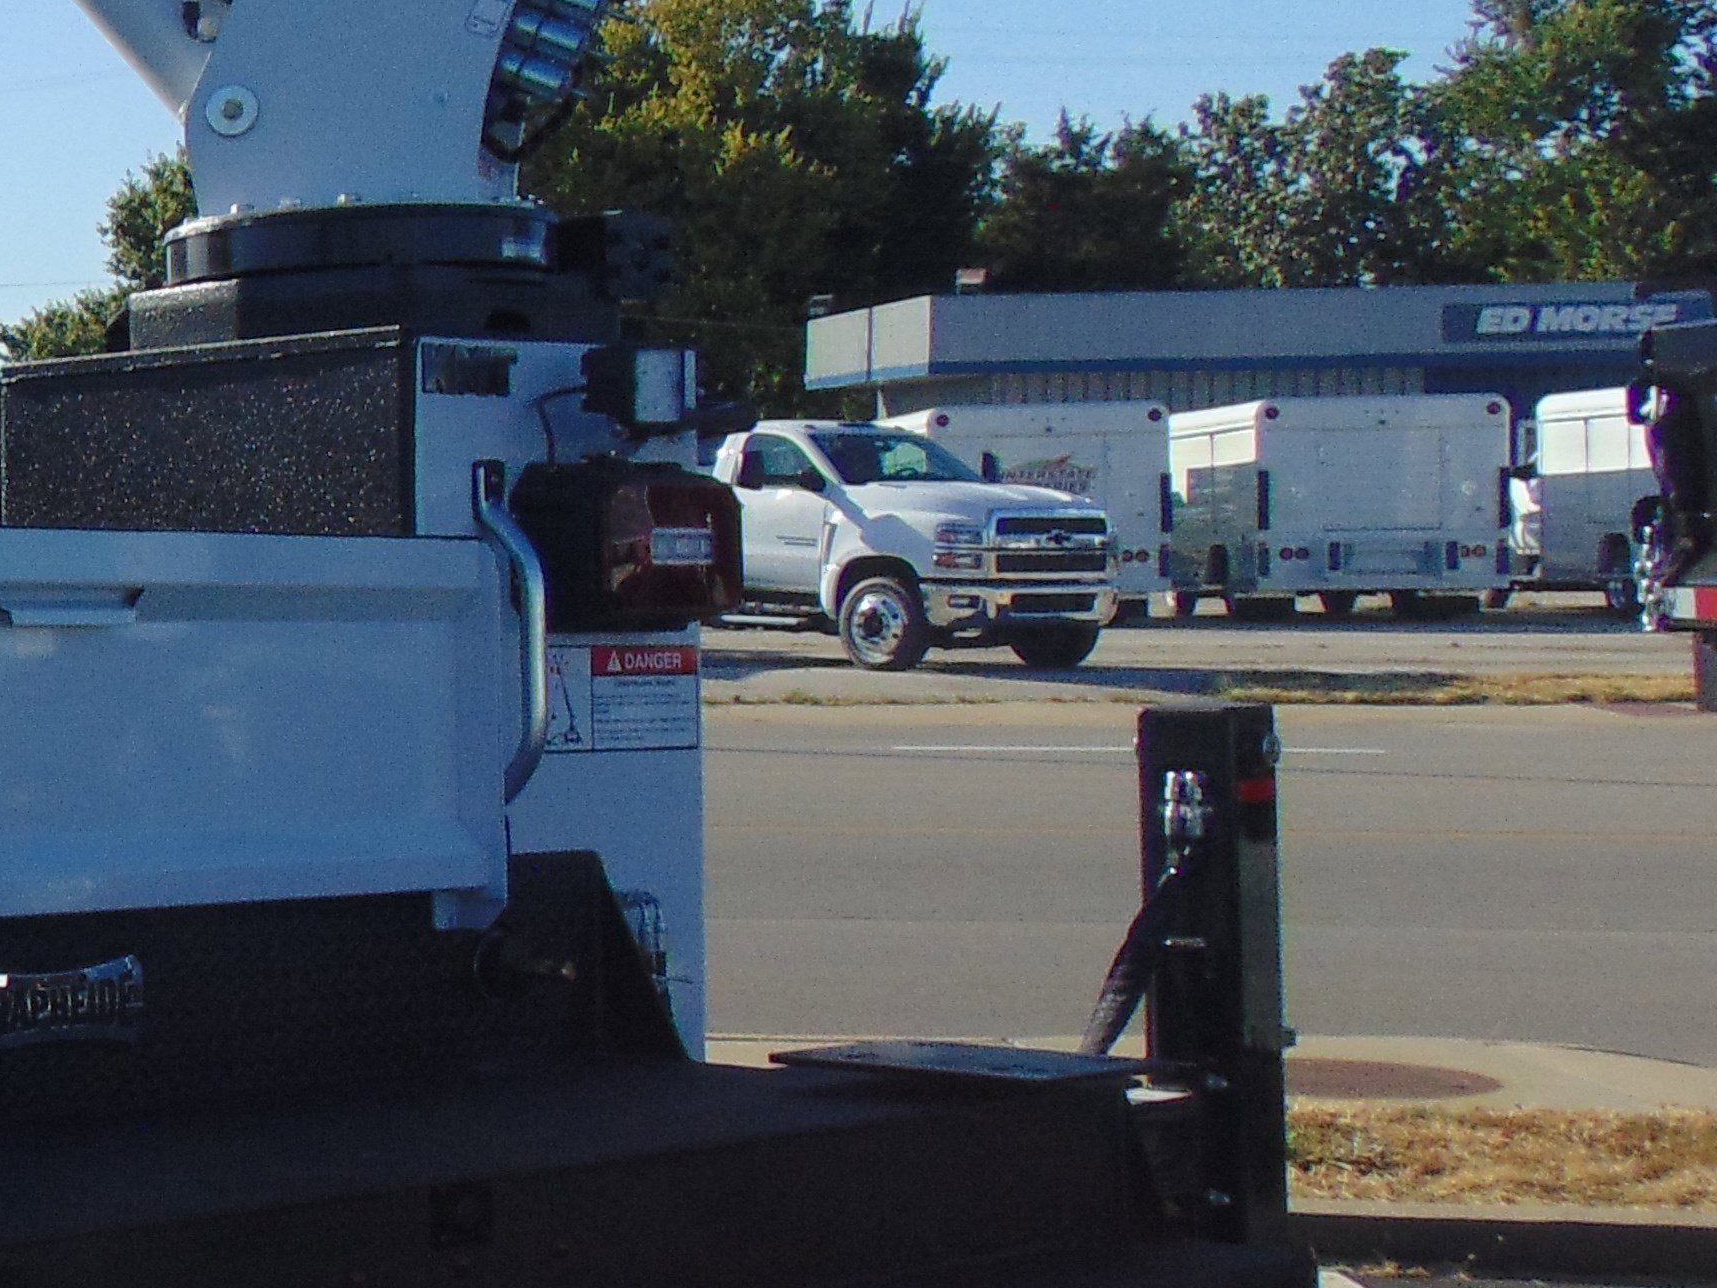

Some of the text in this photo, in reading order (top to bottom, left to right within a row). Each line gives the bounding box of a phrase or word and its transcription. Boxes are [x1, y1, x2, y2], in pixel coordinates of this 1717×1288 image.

[1476, 303, 1679, 335] ED MORSE
[624, 652, 682, 669] DANGER
